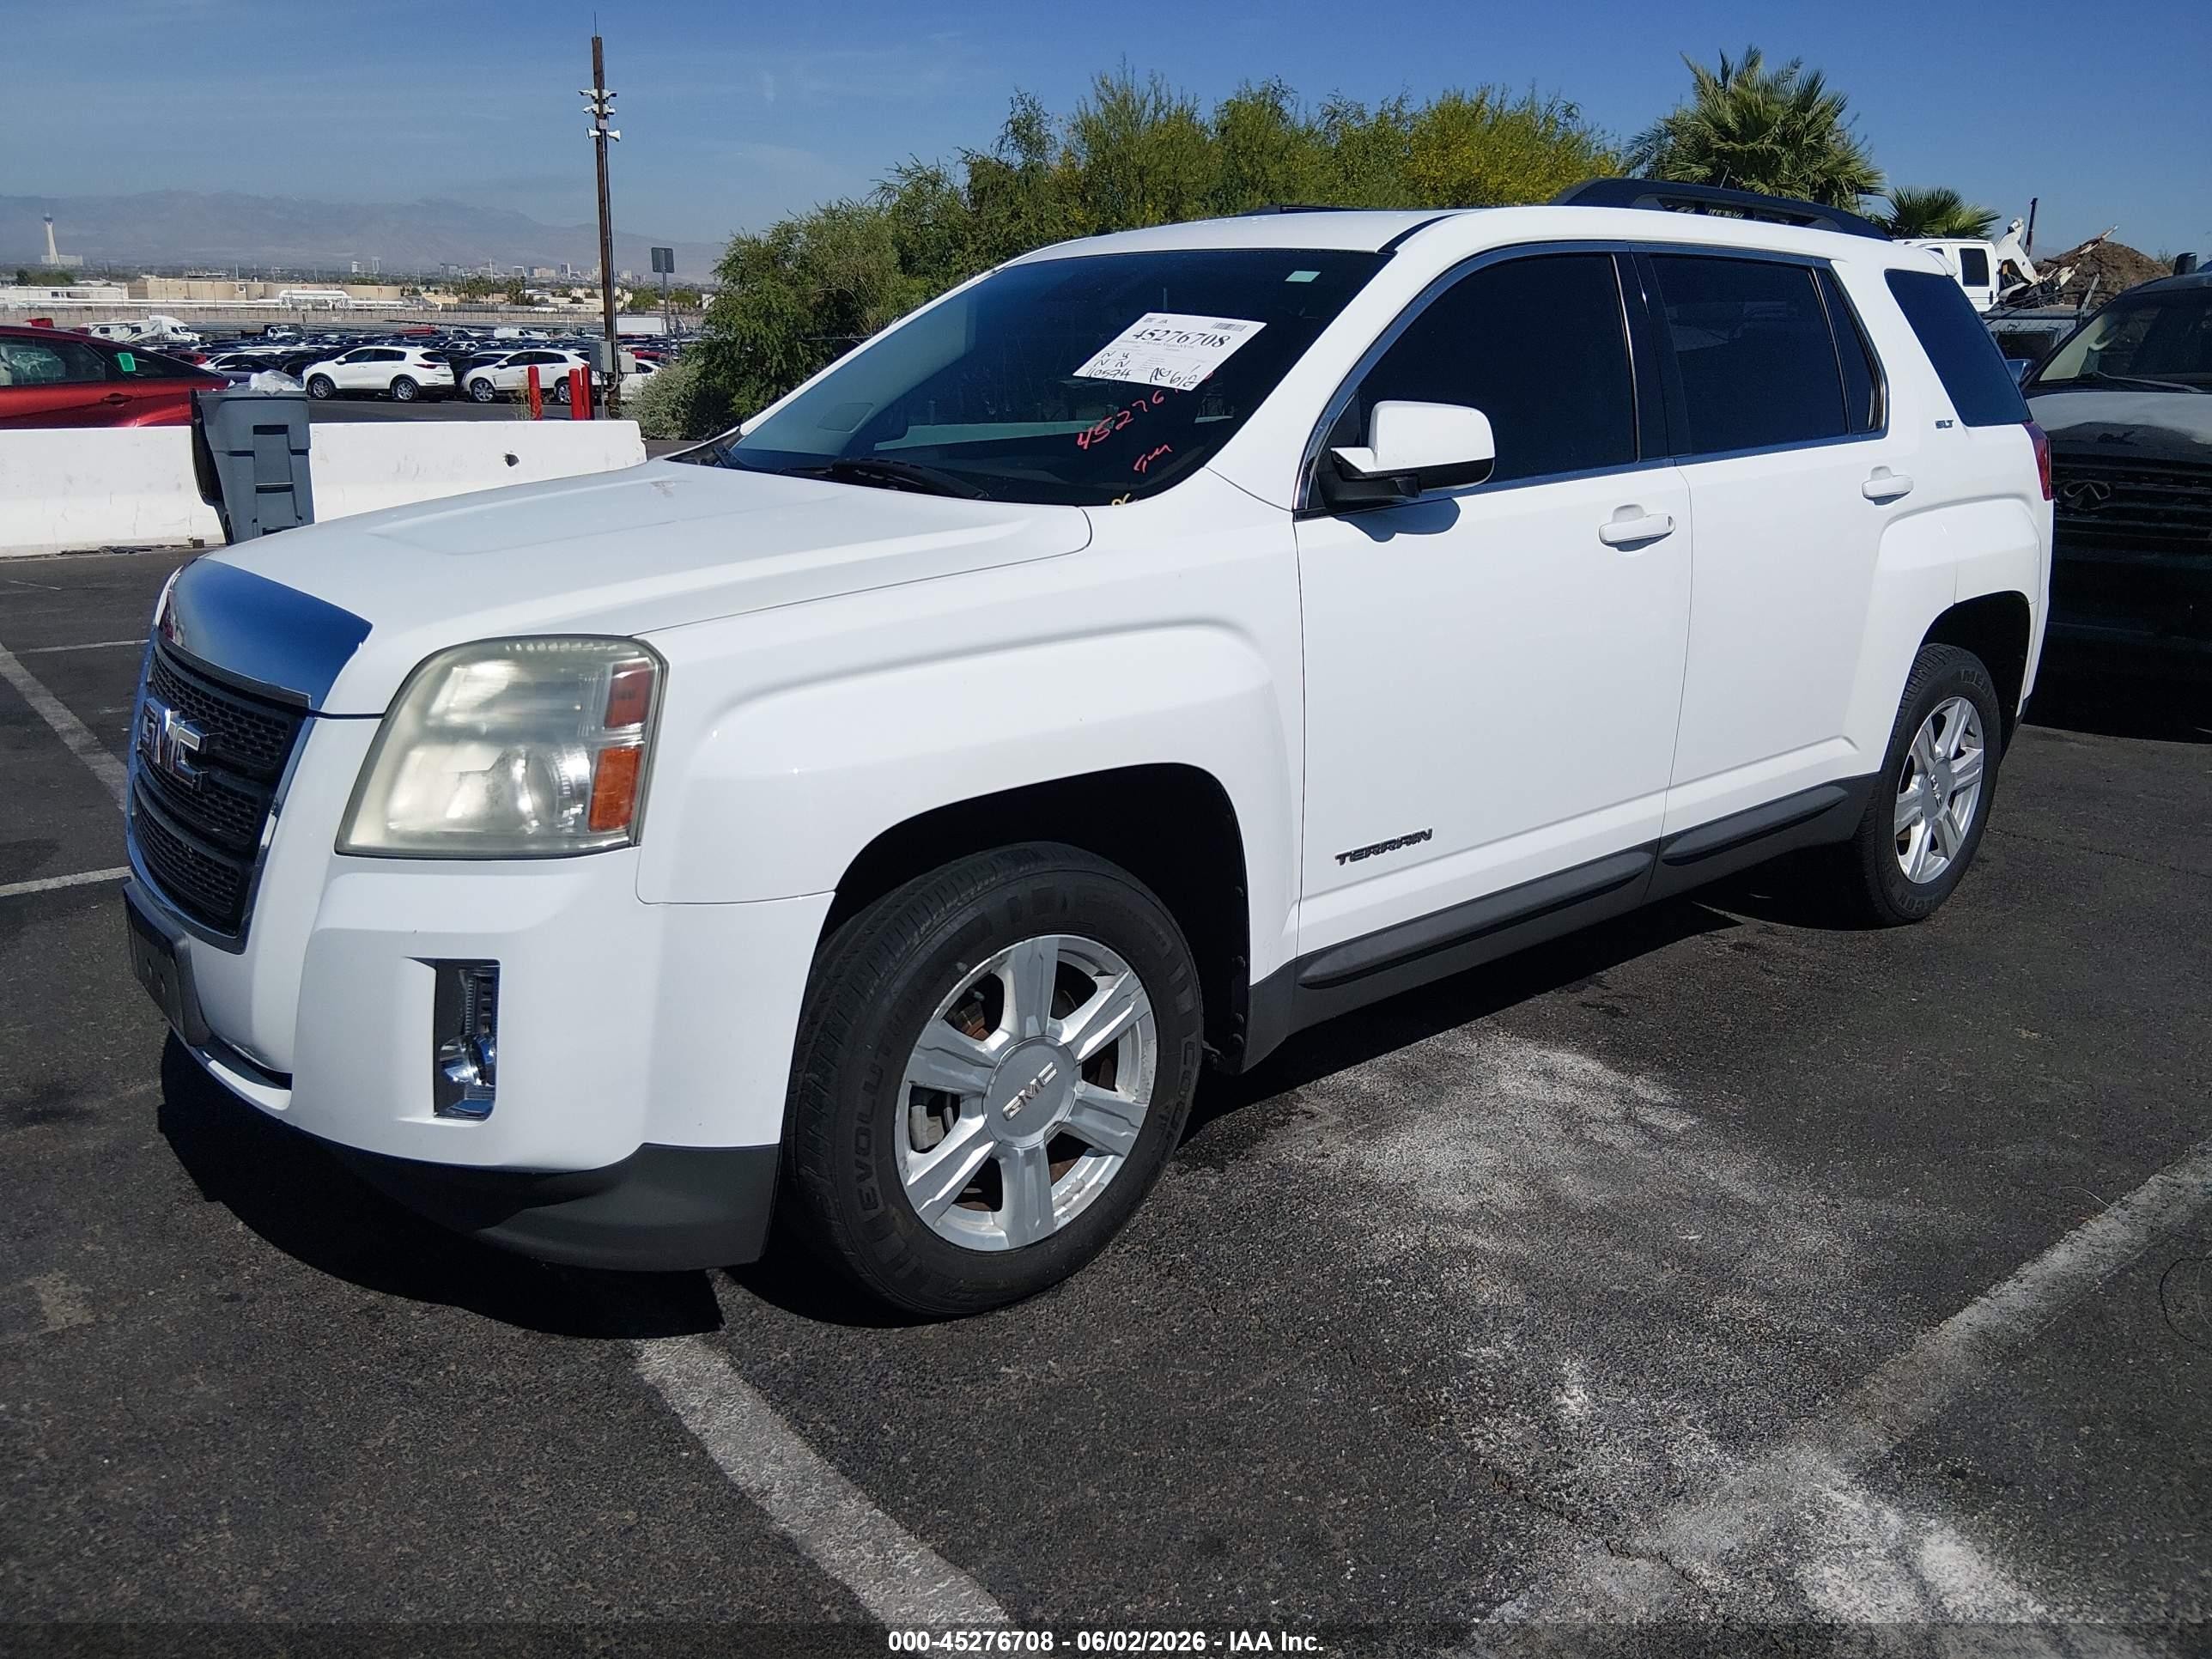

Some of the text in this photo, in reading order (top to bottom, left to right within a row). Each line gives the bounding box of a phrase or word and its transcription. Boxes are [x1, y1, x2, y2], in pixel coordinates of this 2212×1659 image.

[1133, 328, 1231, 348] 45276708
[137, 697, 207, 788] GMC
[1334, 827, 1433, 866] TERRAIN
[1002, 1061, 1057, 1121] GMC
